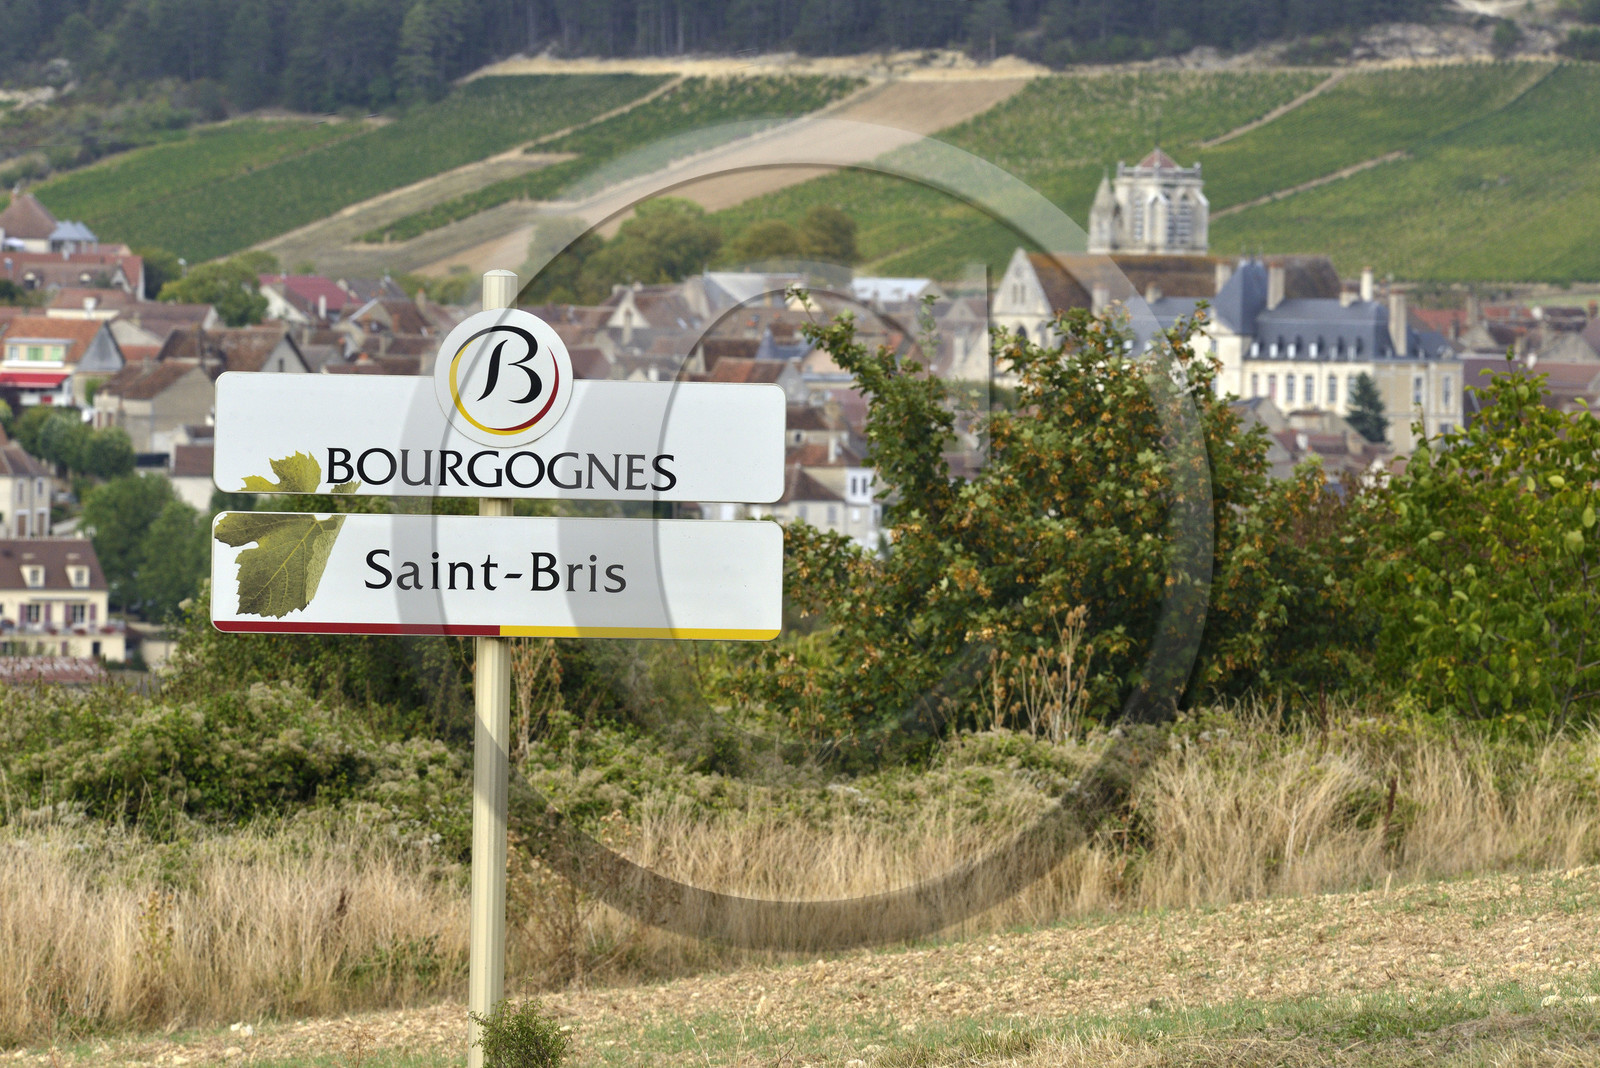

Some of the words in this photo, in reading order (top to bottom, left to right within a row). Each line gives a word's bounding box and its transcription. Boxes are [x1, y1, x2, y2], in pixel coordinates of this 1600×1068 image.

[475, 326, 543, 404] B
[327, 448, 677, 491] BOURGOGNES
[365, 549, 627, 593] Saint-Bris
